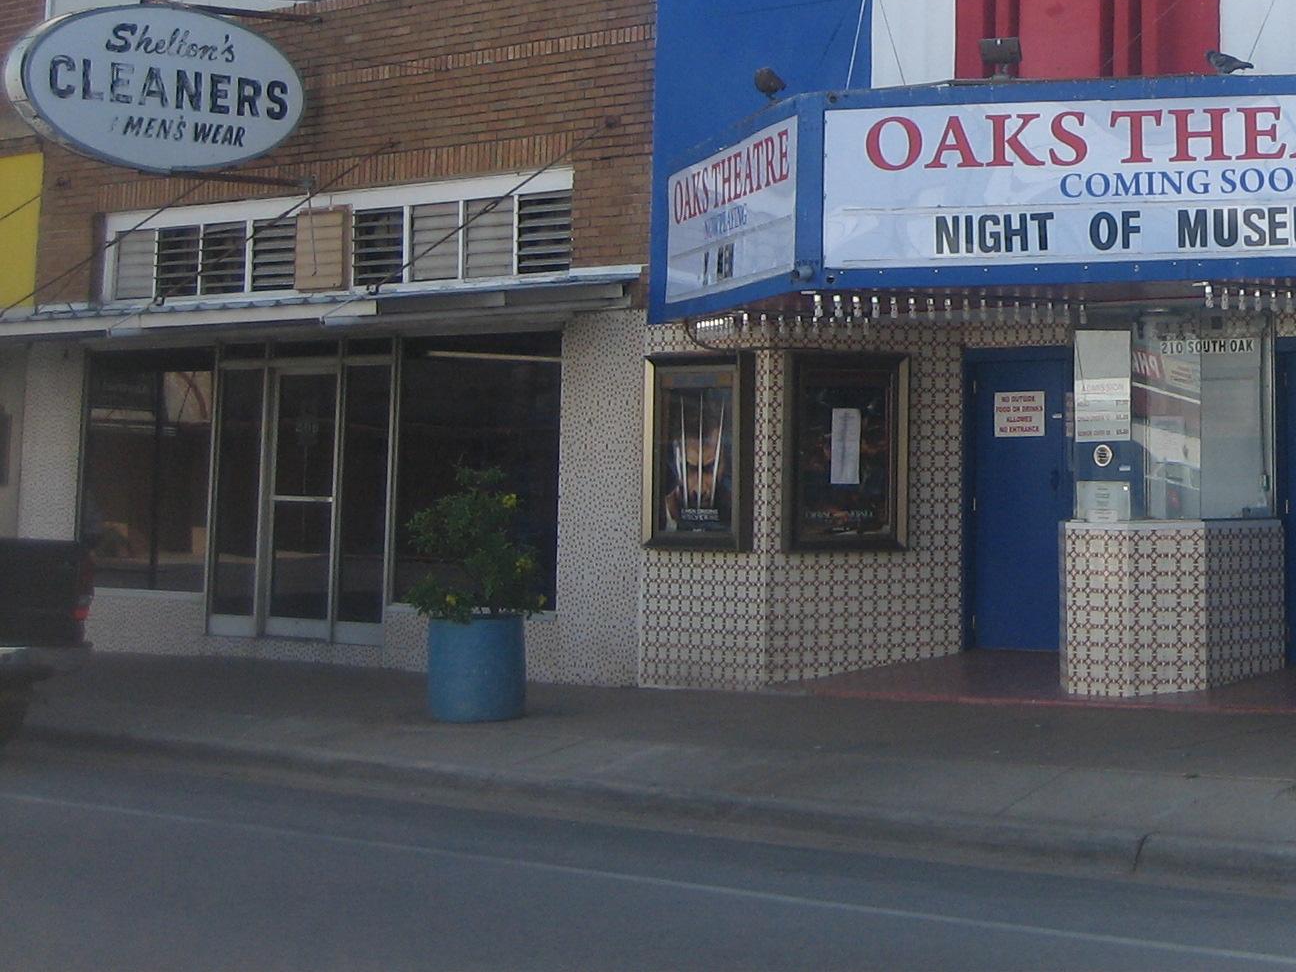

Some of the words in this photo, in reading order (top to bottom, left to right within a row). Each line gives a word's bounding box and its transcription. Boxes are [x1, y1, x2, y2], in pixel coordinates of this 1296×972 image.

[105, 22, 236, 64] Shelton's
[49, 54, 289, 120] CLEANERS
[193, 125, 246, 147] WEAR
[866, 110, 1088, 171] OAKS
[673, 166, 709, 225] OAKS
[712, 129, 790, 208] THEATRE
[1060, 169, 1211, 198] COMING
[935, 212, 1054, 254] NIGHT
[1089, 211, 1141, 251] OF
[1161, 341, 1183, 354] 210
[1187, 340, 1226, 353] SOUTH
[1230, 339, 1253, 352] OAK
